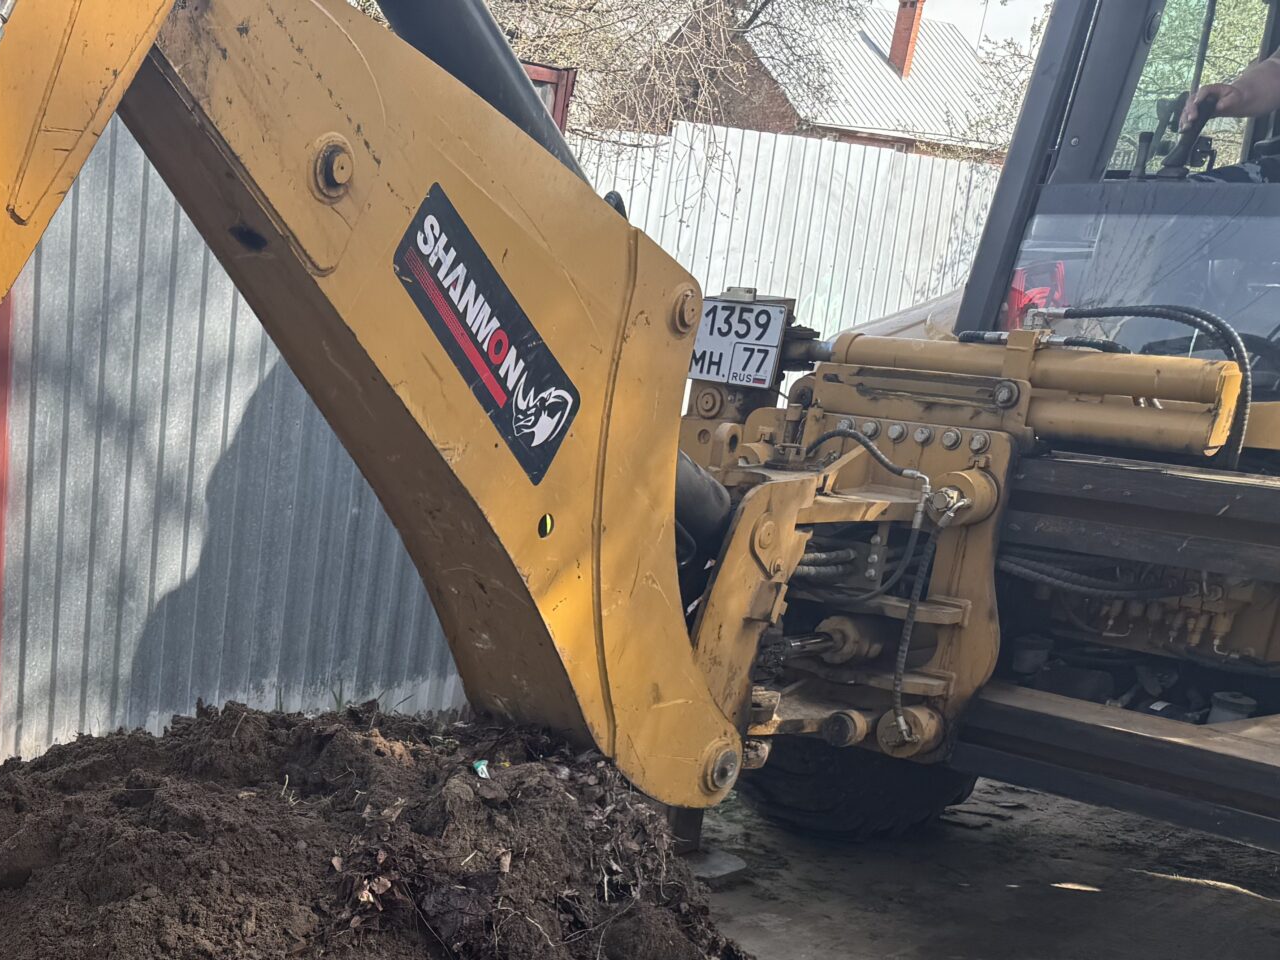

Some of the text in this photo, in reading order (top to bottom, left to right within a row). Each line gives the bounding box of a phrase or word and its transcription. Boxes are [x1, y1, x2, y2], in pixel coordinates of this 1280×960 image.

[417, 215, 524, 390] SHANMON
[705, 305, 771, 341] 1359
[741, 347, 769, 373] 77
[731, 372, 752, 382] RUS
